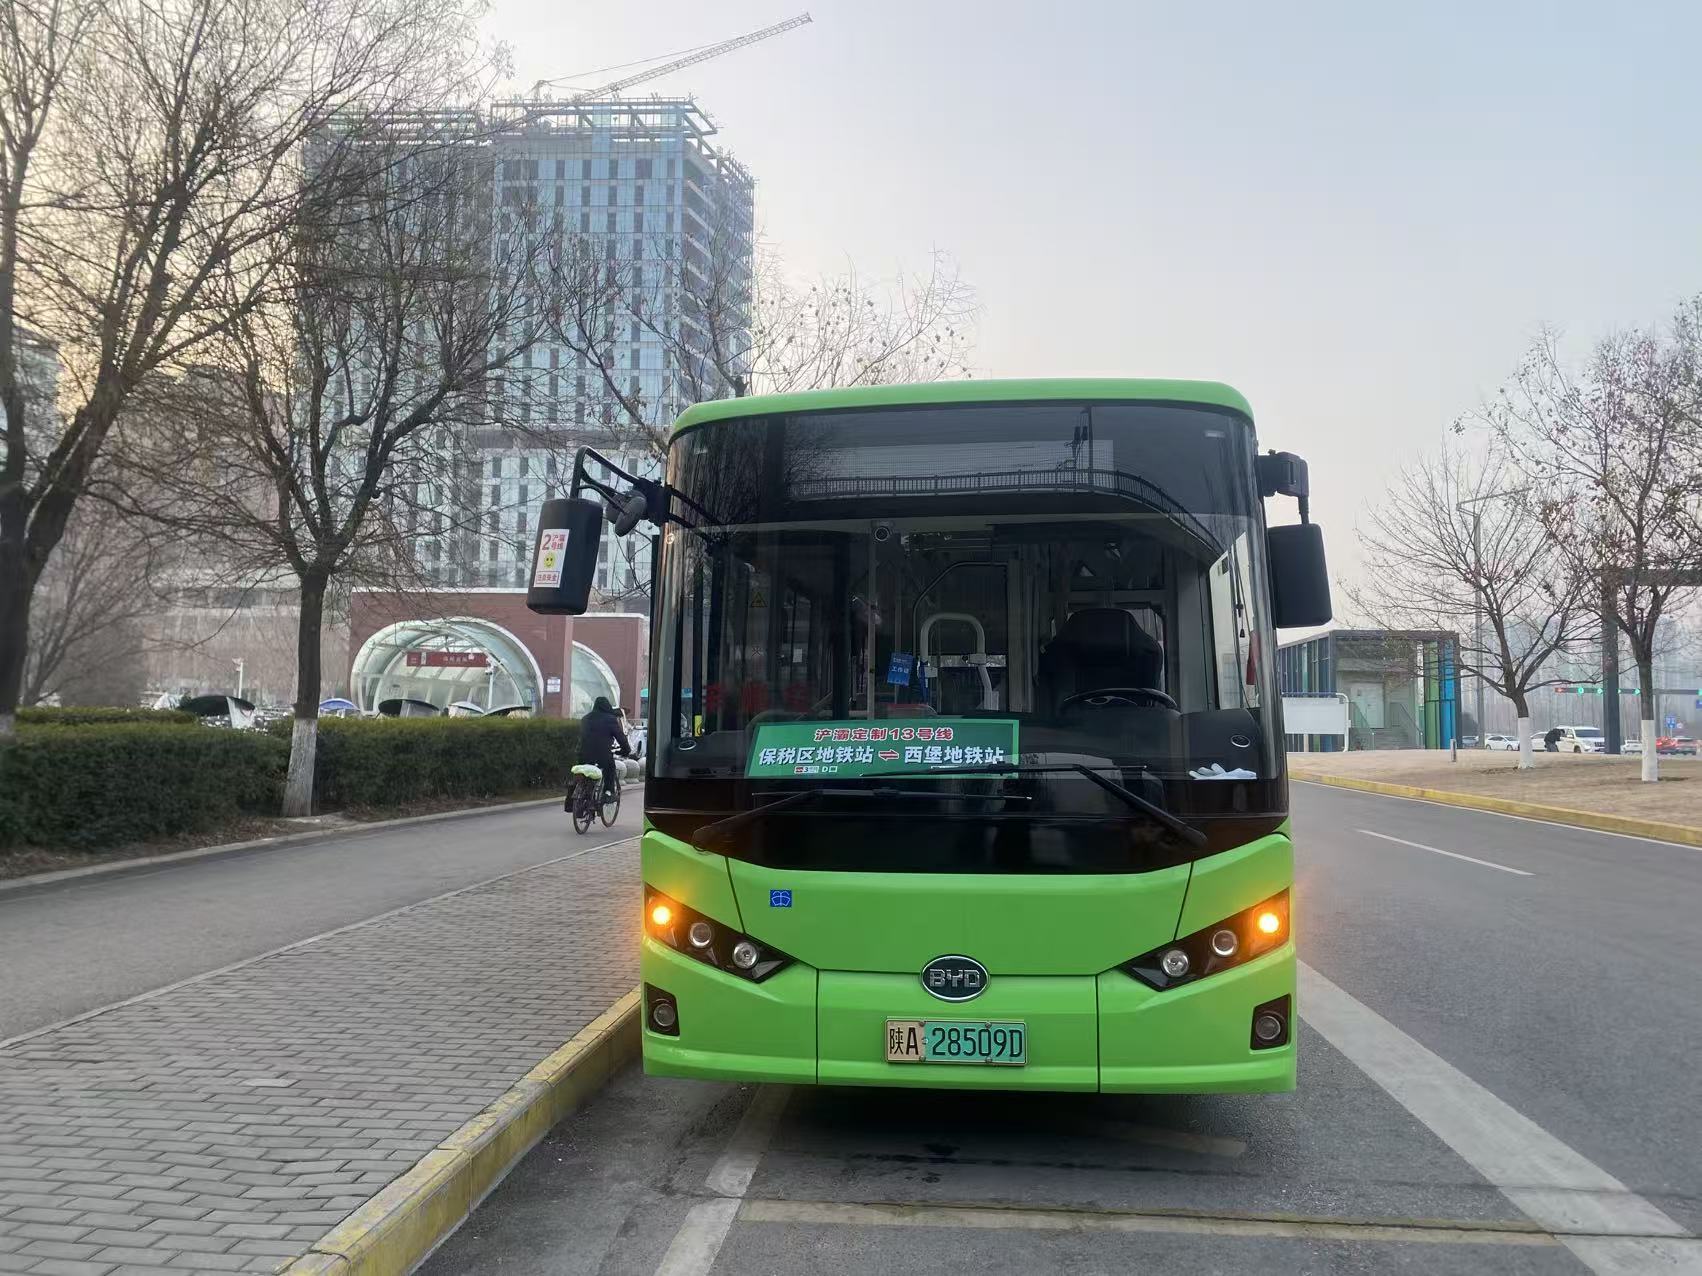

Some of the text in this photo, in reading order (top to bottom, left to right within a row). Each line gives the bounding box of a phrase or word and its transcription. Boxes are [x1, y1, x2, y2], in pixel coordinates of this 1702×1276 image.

[813, 727, 953, 742] 浐灞定制13号线
[758, 746, 1004, 765] 保税区地铁站 西堡地铁站
[929, 968, 980, 988] BYD
